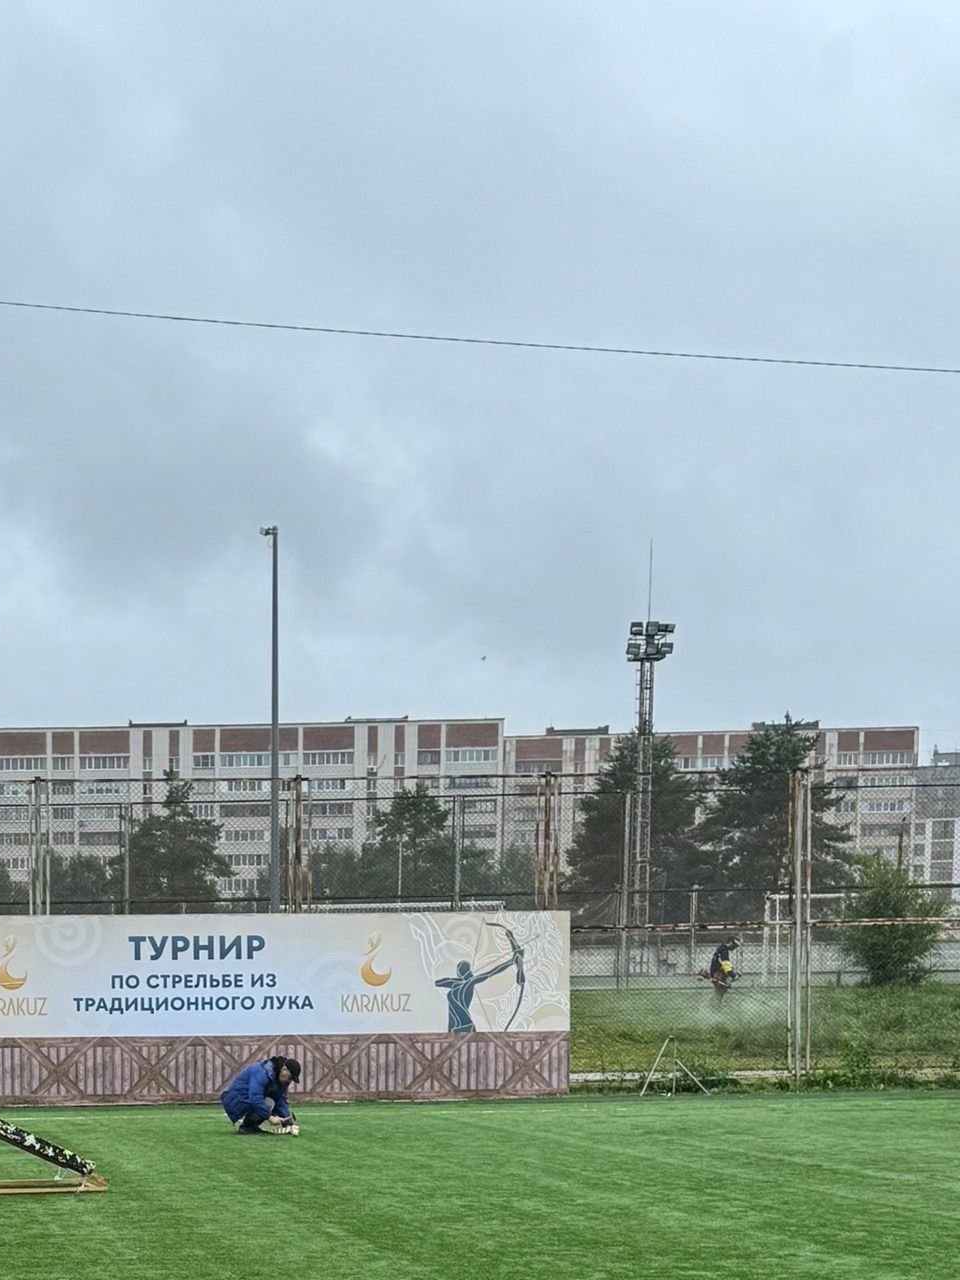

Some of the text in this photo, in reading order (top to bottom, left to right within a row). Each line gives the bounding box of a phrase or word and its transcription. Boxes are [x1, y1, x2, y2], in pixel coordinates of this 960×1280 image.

[128, 935, 266, 961] ТУРНИР
[111, 973, 277, 989] ПО СТРЕЛЬБЕ ИЗ
[73, 995, 314, 1015] ТРАДИЦИОННОГО ЛУКА
[341, 993, 412, 1013] KARAKUZ
